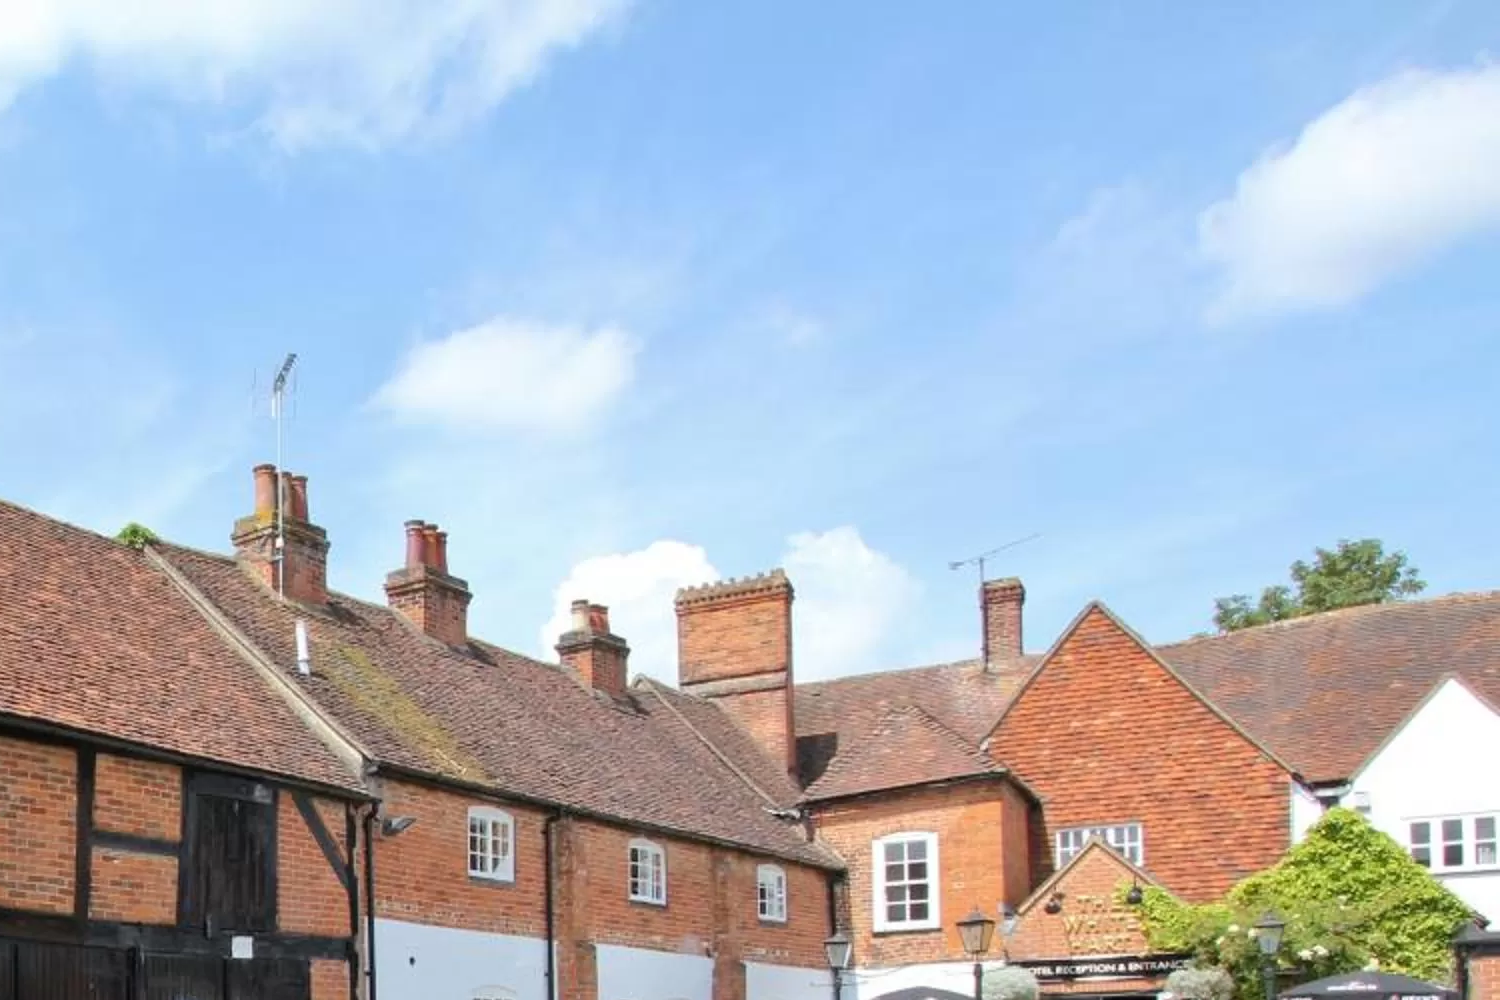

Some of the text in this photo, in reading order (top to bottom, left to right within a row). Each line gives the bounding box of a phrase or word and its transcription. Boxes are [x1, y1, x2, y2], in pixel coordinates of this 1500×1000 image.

[1076, 893, 1123, 913] THE
[1063, 911, 1140, 935] WHITE
[1069, 934, 1131, 954] HART
[1027, 966, 1053, 976] OTEL
[1055, 962, 1116, 975] RECEPTION
